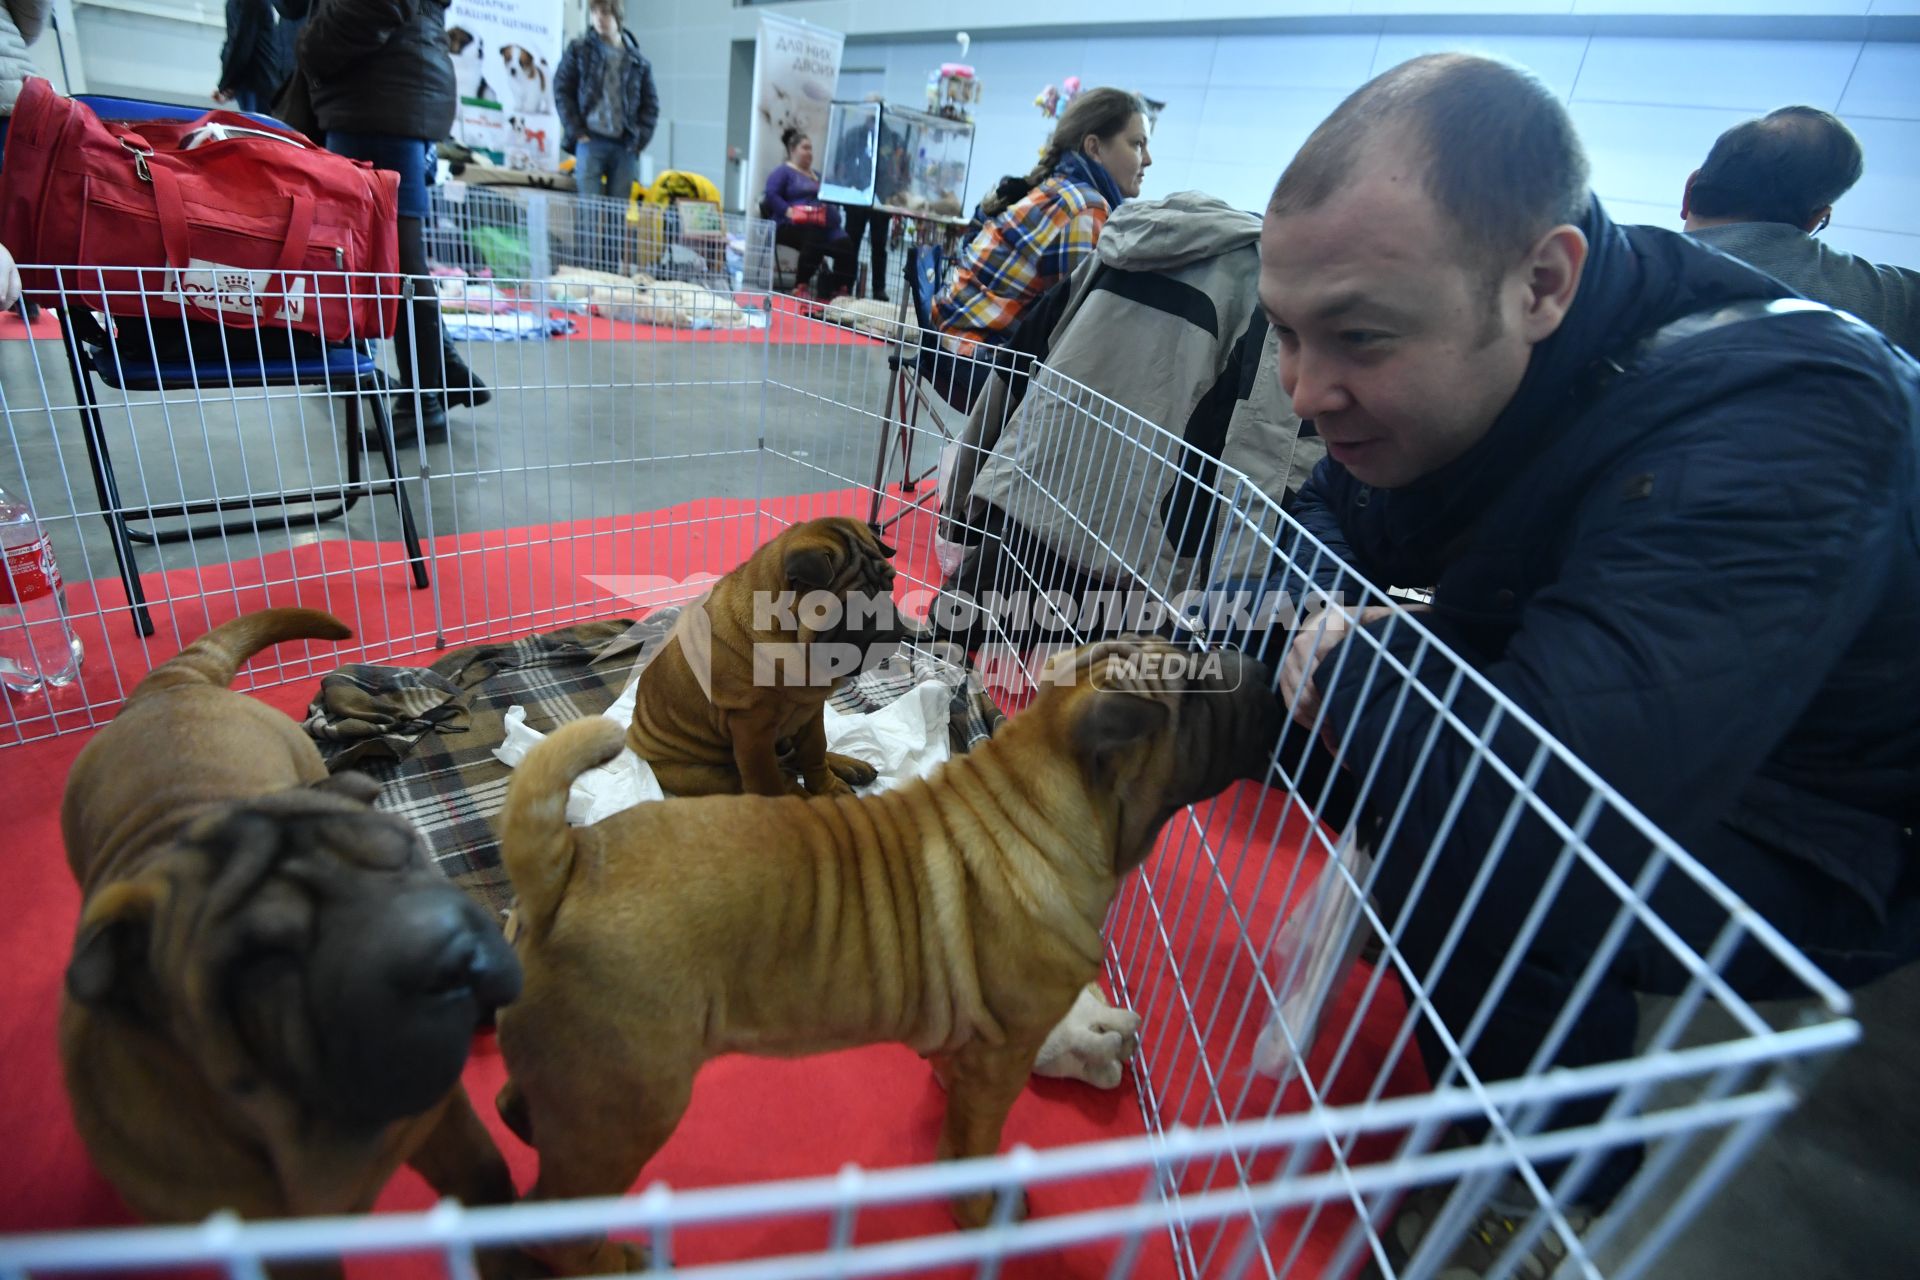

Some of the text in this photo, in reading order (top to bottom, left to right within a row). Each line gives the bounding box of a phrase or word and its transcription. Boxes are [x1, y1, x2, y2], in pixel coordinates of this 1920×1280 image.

[775, 36, 832, 60] ДЛЯ НИХ
[792, 57, 835, 77] ДВОИХ
